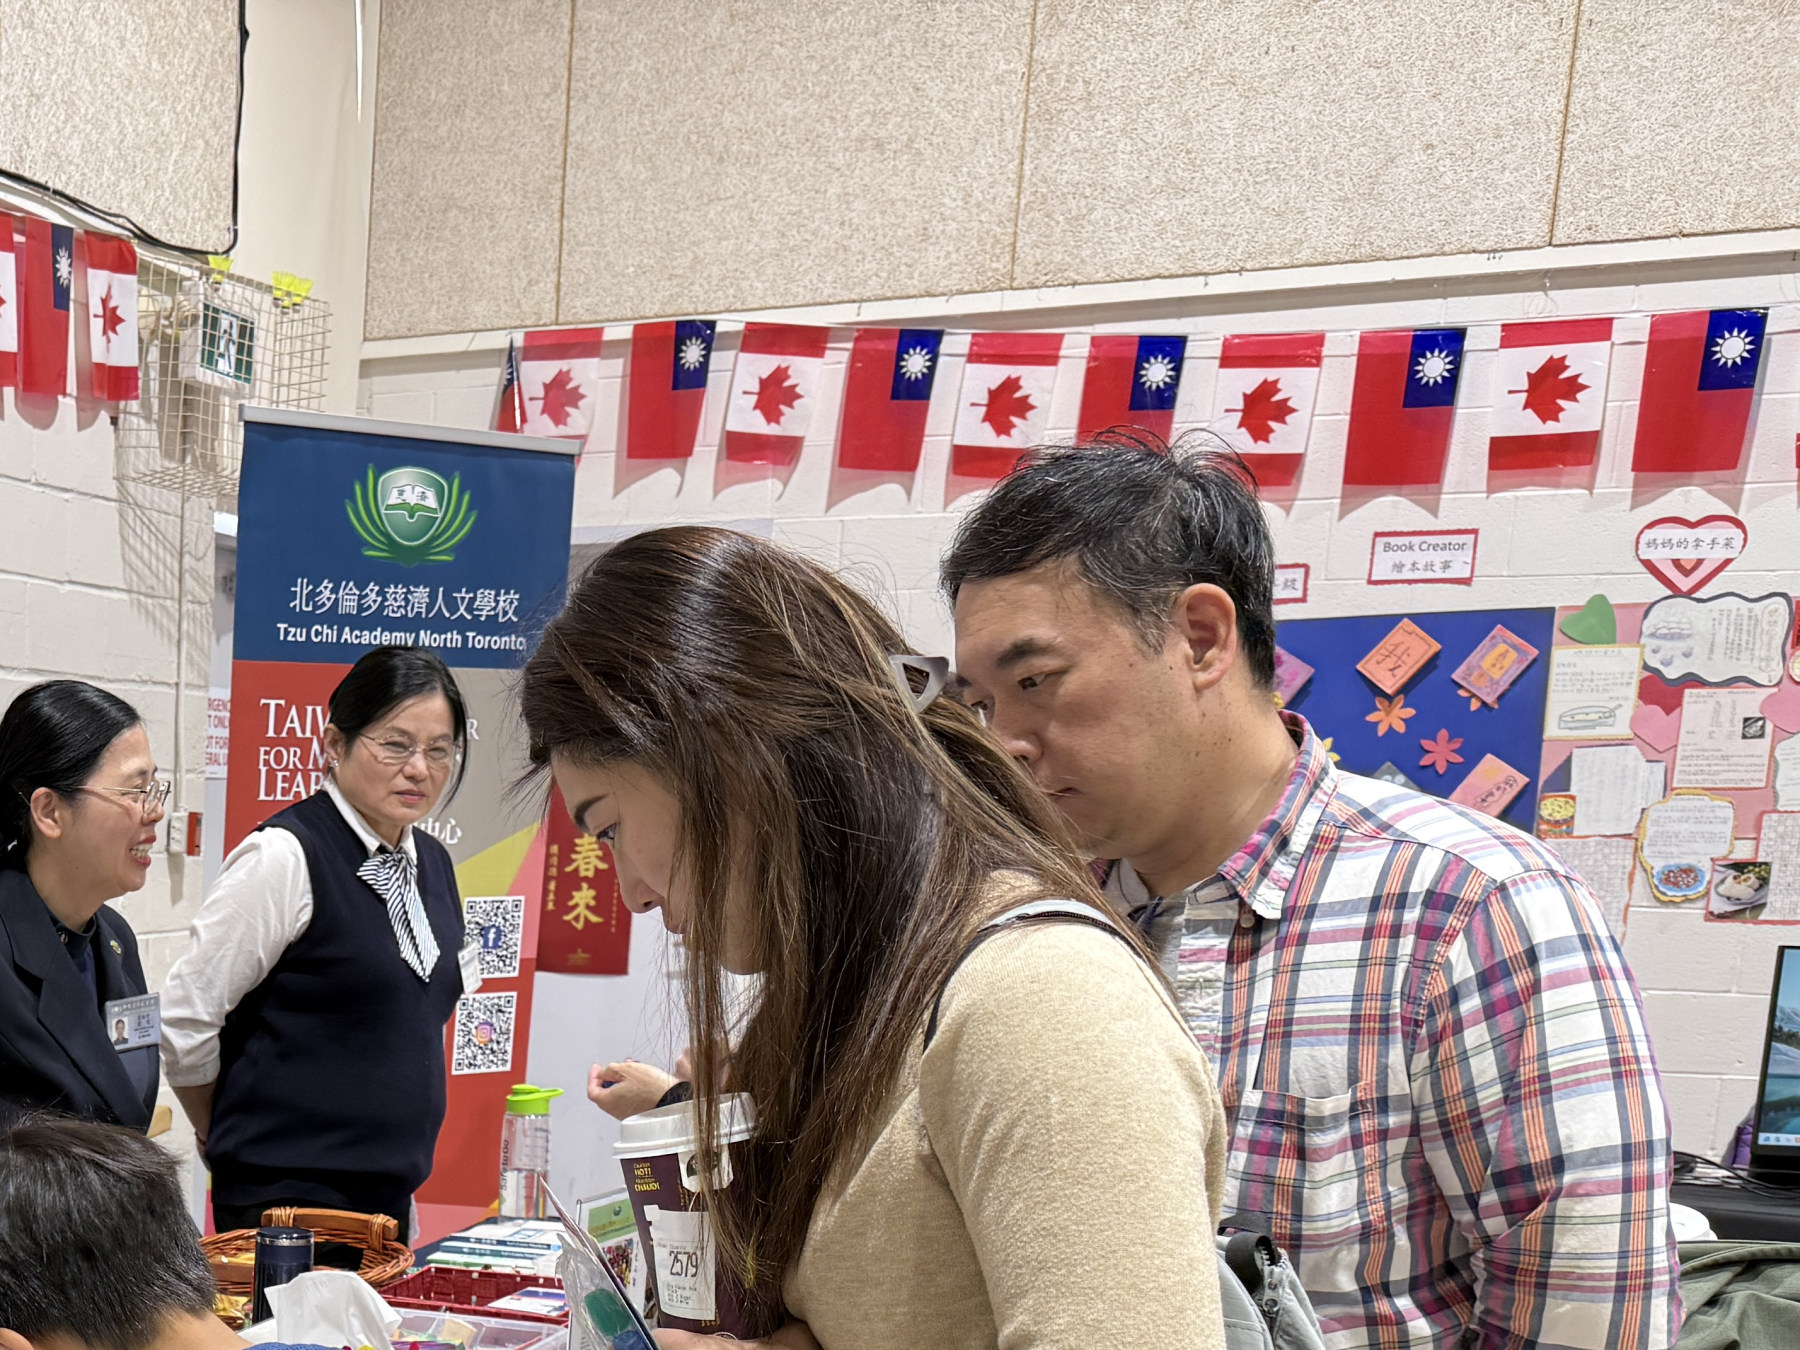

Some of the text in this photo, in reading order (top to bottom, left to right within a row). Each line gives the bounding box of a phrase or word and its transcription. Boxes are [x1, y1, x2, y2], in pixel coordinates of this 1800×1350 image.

[1383, 540, 1468, 553] Book Creator
[1644, 536, 1736, 551] 媽媽的拿手菜
[289, 576, 521, 623] 北多倫多慈濟人文學校
[276, 623, 526, 651] Tzu Chi Academy North Toronto
[258, 746, 304, 770] FOR
[562, 832, 609, 931] 春來
[669, 1250, 699, 1278] 2579
